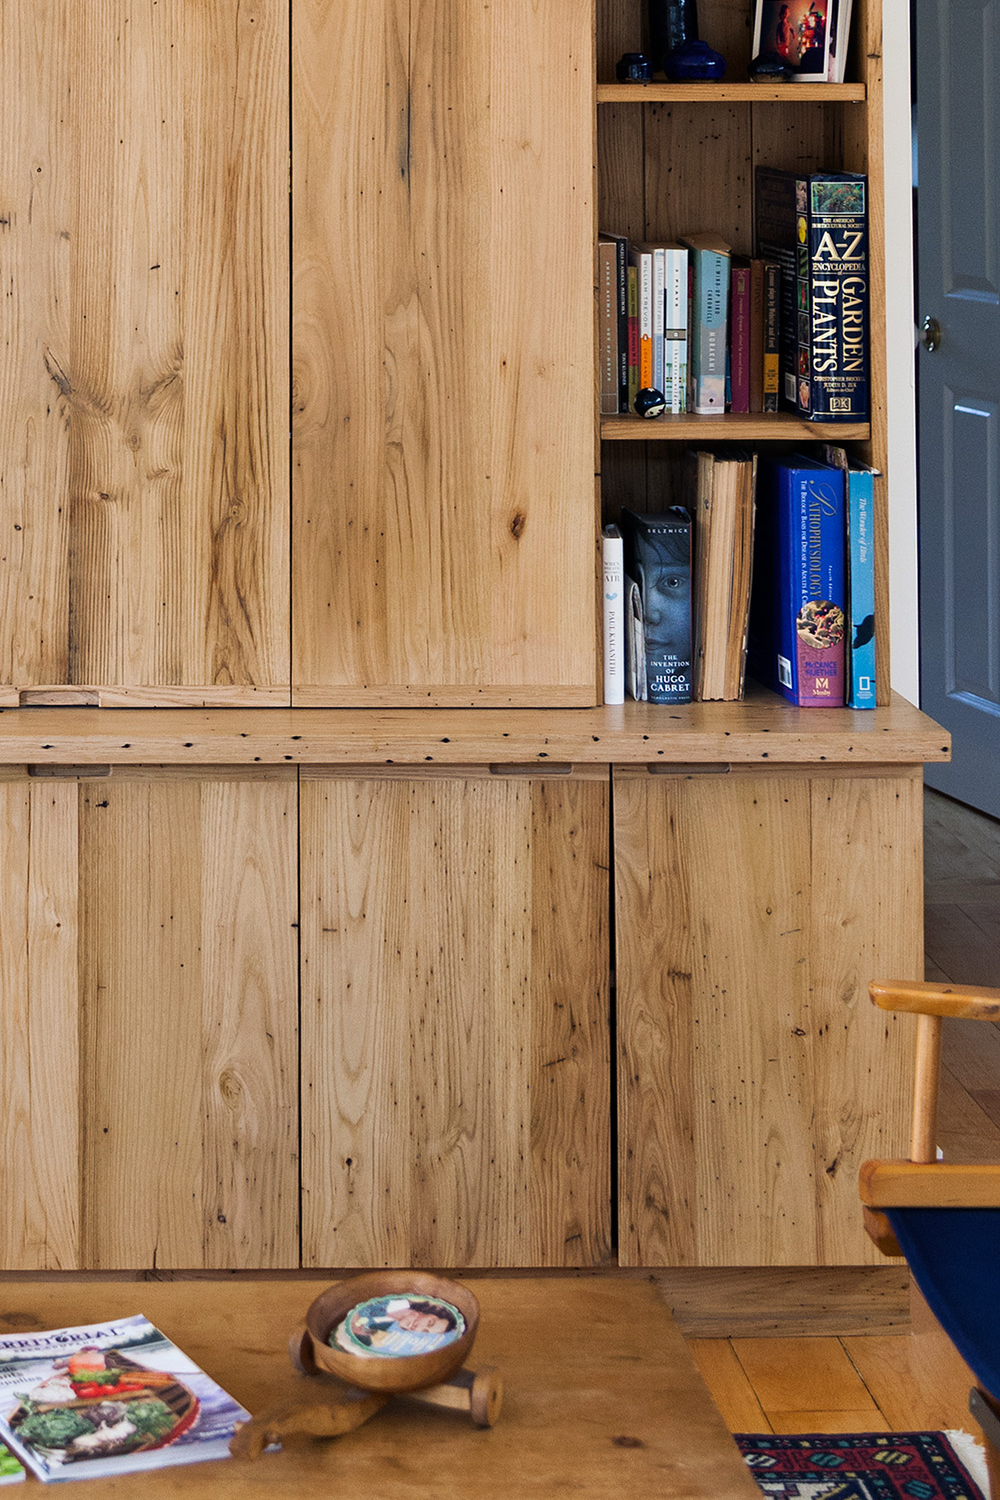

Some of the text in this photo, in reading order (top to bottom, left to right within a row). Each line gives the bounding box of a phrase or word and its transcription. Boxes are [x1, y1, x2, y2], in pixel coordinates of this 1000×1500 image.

[811, 230, 865, 262] A-Z
[812, 262, 866, 272] ENCYCLOPEDIA
[812, 278, 840, 373] PLANTS
[841, 276, 867, 372] GARDEN
[708, 331, 716, 372] MURAKAMI
[832, 398, 848, 410] DK
[859, 498, 867, 537] The Wonder
[808, 479, 839, 598] PATHOPHYSIOLOGY
[608, 610, 616, 676] PAUL KALANITHI
[650, 683, 690, 693] CABRET
[656, 674, 685, 683] HUGO
